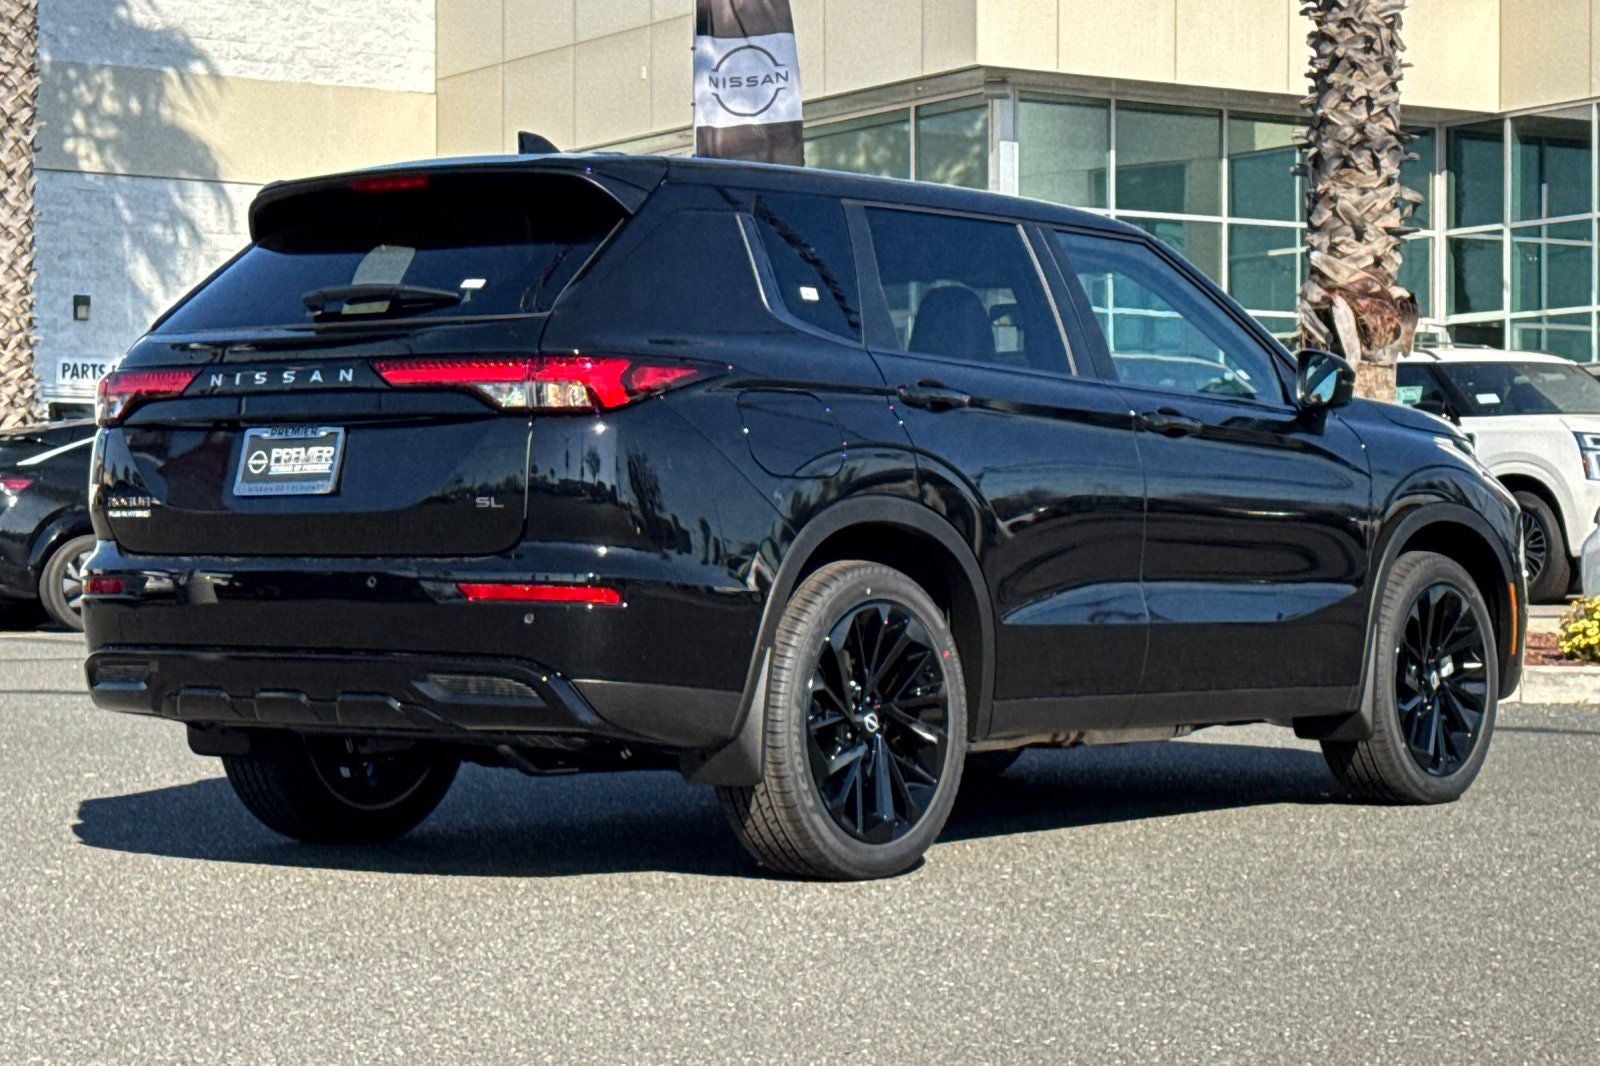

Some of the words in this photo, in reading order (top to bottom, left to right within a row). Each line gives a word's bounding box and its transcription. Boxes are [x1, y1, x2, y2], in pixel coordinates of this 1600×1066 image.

[708, 71, 789, 88] NISSAN
[61, 362, 106, 379] PARTS
[210, 368, 353, 386] NISSAN
[269, 424, 318, 436] PREMIER
[270, 446, 335, 465] PREMIER
[475, 496, 504, 508] SL
